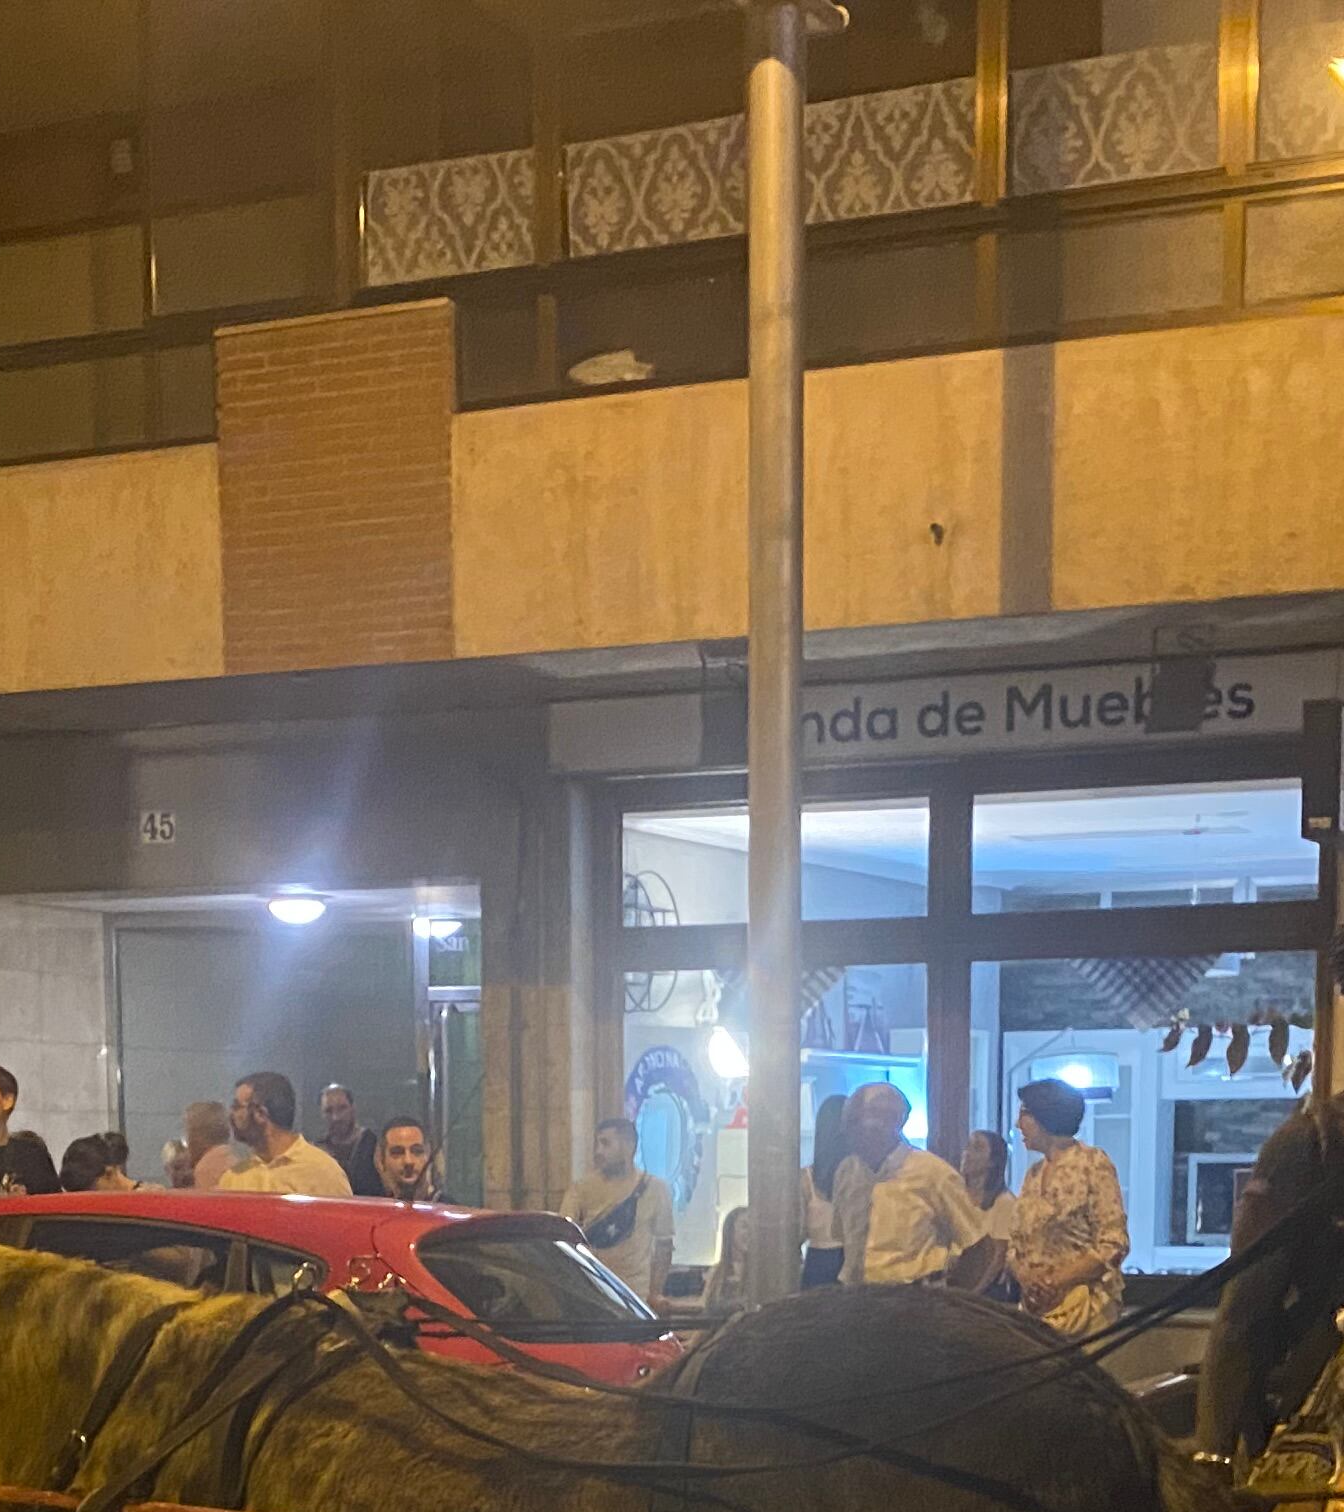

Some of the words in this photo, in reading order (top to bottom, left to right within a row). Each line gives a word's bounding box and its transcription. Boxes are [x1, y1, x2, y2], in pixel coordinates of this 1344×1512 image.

[799, 696, 899, 745] nda
[917, 690, 986, 738] de
[1005, 676, 1256, 733] Muebes
[143, 812, 174, 841] 45
